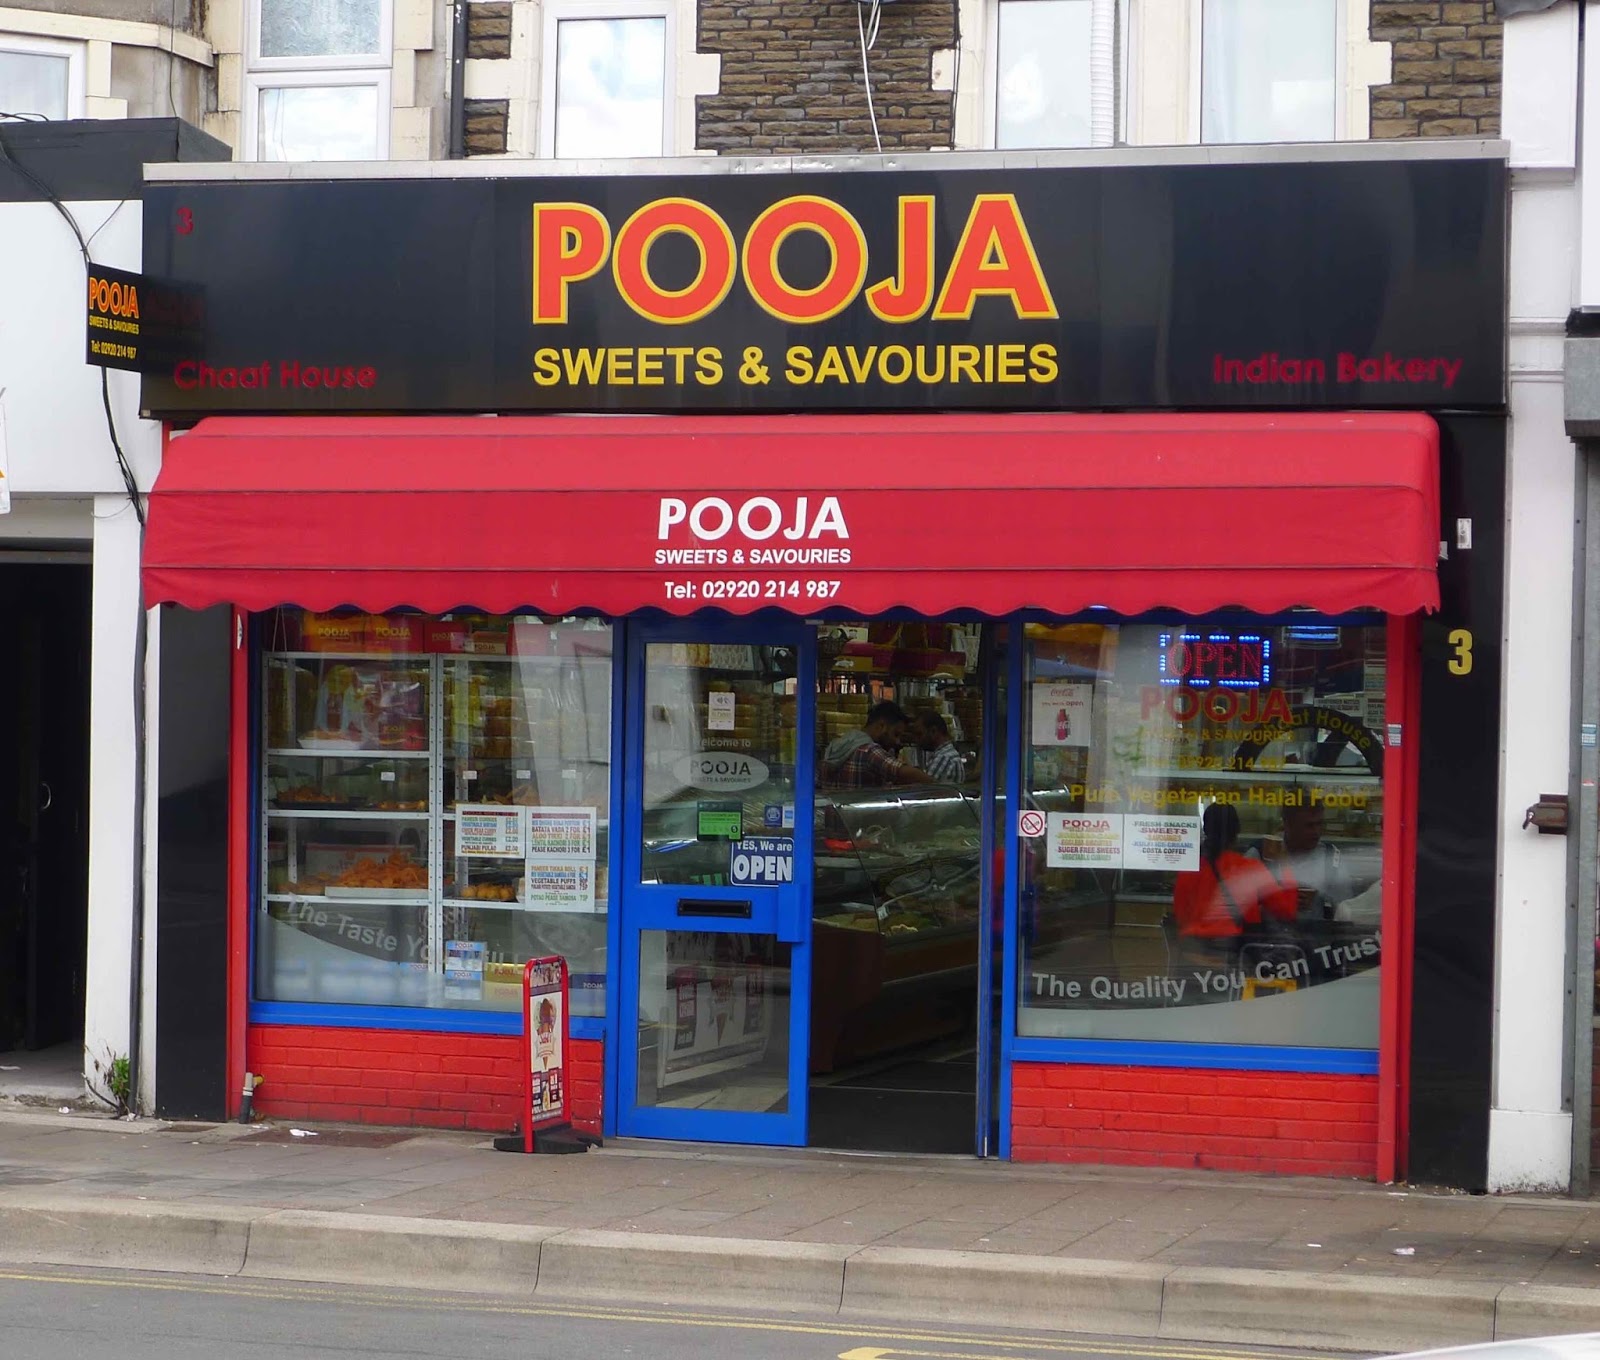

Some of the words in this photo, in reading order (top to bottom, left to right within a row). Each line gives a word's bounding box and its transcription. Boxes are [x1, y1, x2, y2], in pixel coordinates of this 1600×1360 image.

[176, 207, 194, 235] 3
[532, 193, 1060, 326] POOJA
[89, 277, 139, 319] POOJA
[89, 315, 108, 330] SWEETS
[113, 320, 139, 335] SAVOURIES
[91, 340, 101, 353] Tel:
[101, 342, 116, 356] 02920
[117, 344, 126, 357] 214
[127, 347, 137, 359] 987
[173, 360, 271, 390] Chaat
[280, 360, 378, 390] House
[533, 346, 724, 387] SWEETS
[738, 345, 771, 386] &
[784, 343, 1058, 385] SAVOURIES
[1213, 352, 1326, 384] Indian
[1336, 351, 1464, 388] Bakery
[658, 496, 850, 541] POOJA
[654, 548, 728, 564] SWEETS
[732, 548, 745, 564] &
[749, 548, 851, 564] SAVOURIES
[664, 580, 697, 599] Tel:
[702, 580, 760, 598] 02920
[764, 580, 800, 598] 214
[806, 580, 841, 598] 987
[1167, 642, 1263, 679] OPEN
[1448, 628, 1473, 676] 3
[1140, 685, 1293, 724] POOJA
[694, 737, 739, 748] elcome
[1316, 709, 1371, 749] House
[1248, 787, 1302, 808] Halal
[1311, 786, 1368, 808] Food
[1062, 819, 1110, 828] POOJA
[1140, 827, 1188, 835] SWEETS
[1163, 821, 1198, 829] SNACKS
[736, 840, 758, 853] YES,
[760, 840, 775, 851] We
[776, 843, 793, 852] are
[733, 854, 793, 881] OPEN
[284, 890, 329, 928] The
[337, 913, 398, 952] Taste
[1032, 972, 1082, 999] The
[1090, 975, 1187, 1002] Quality
[1193, 969, 1247, 995] You
[1255, 955, 1309, 984] Can
[1314, 930, 1381, 971] Trust
